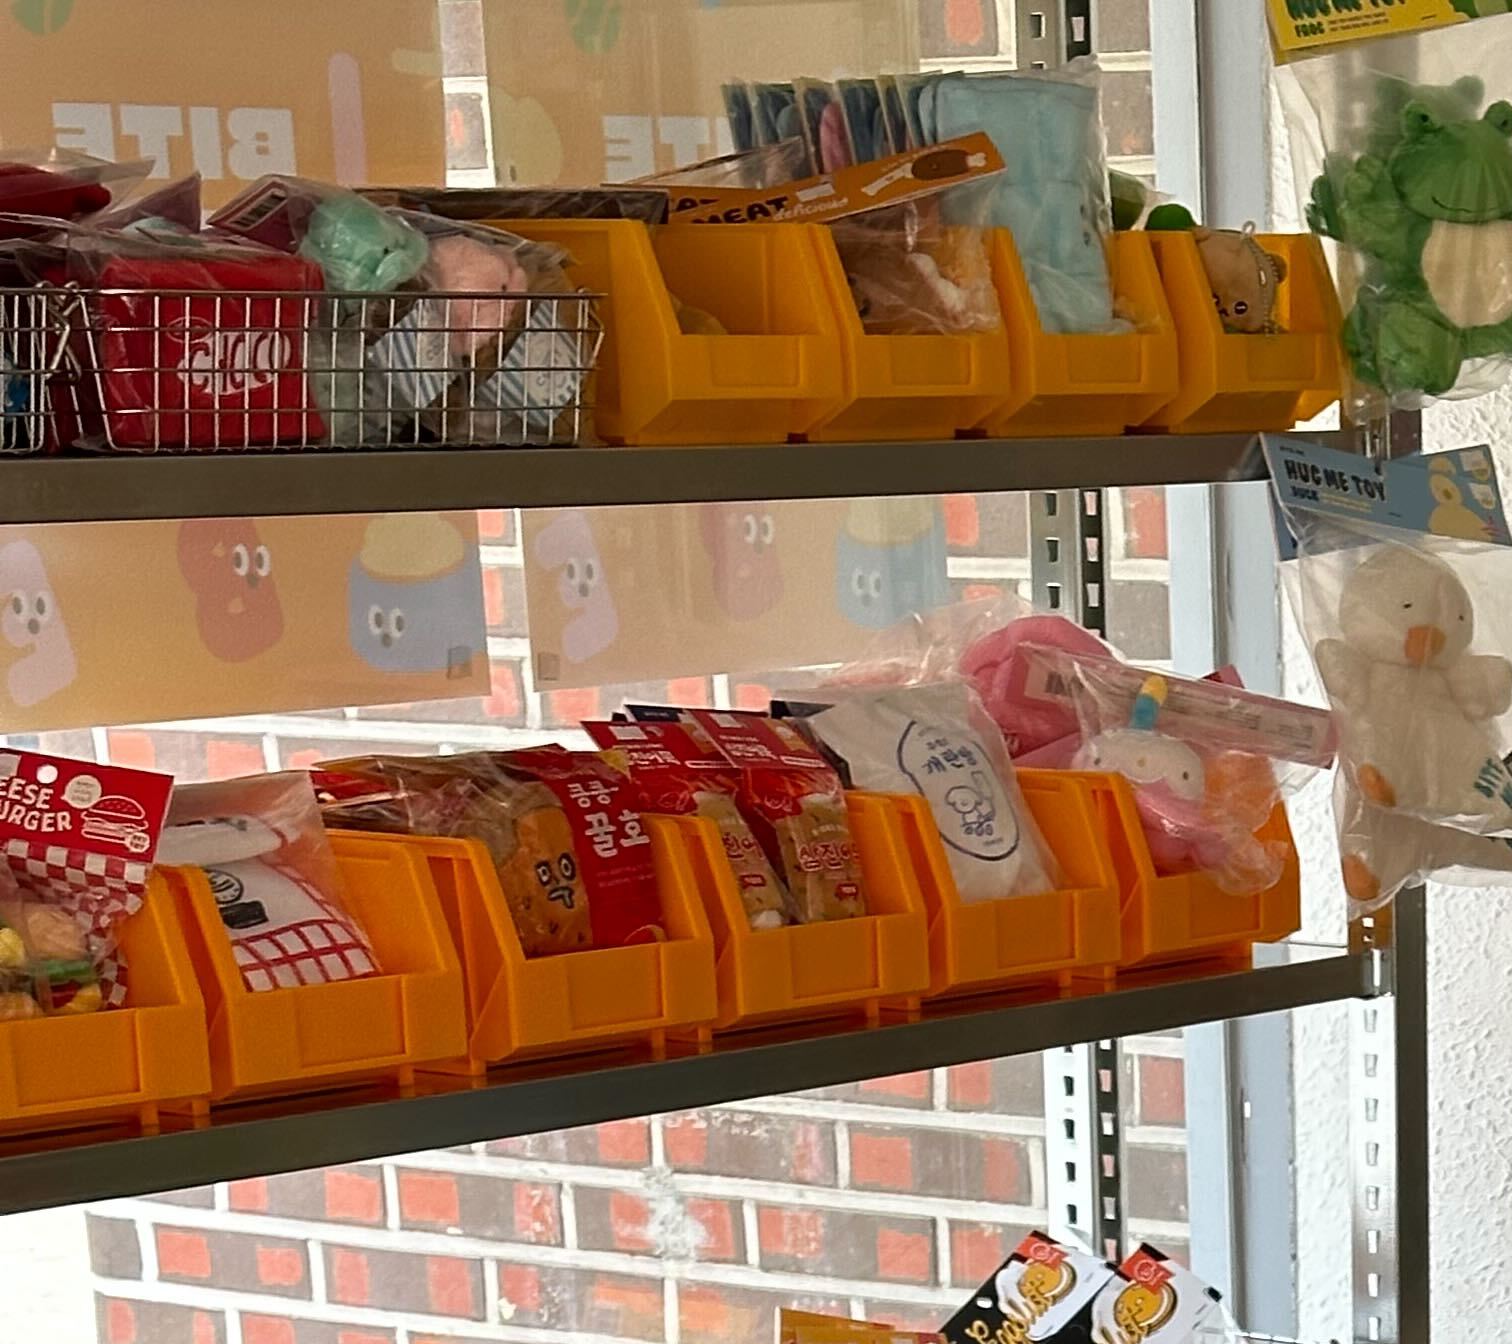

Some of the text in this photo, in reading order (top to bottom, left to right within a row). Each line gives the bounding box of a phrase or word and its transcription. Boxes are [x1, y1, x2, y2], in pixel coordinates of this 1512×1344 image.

[1284, 459, 1323, 487] HUG
[1323, 467, 1350, 493] ME
[1351, 475, 1386, 502] TOY
